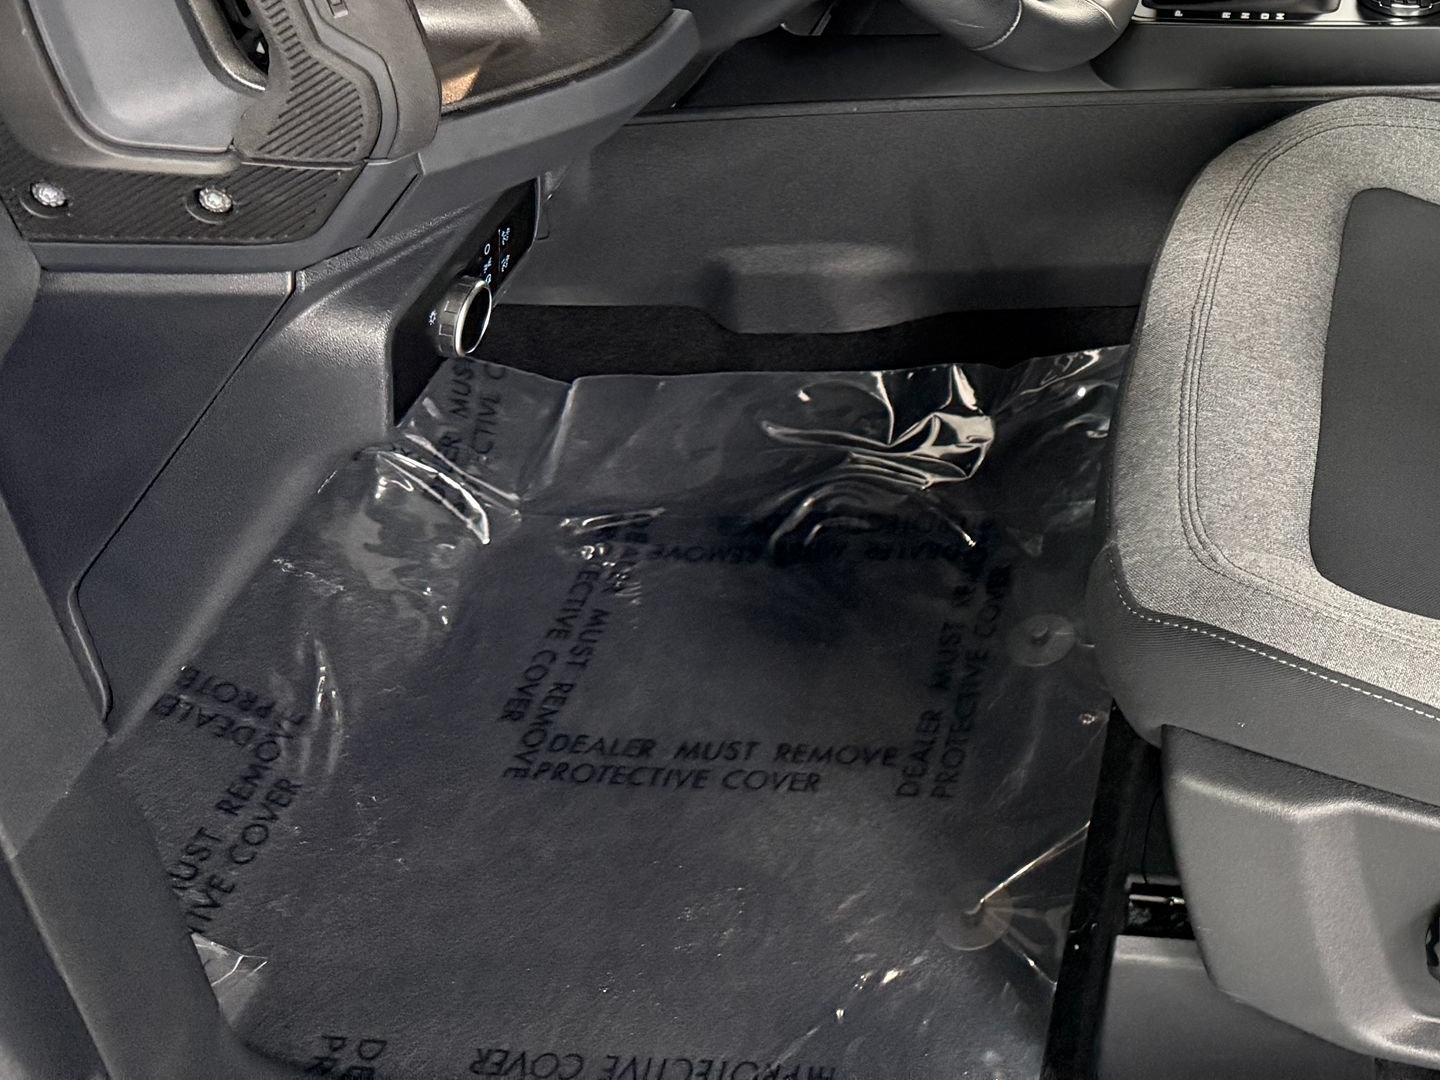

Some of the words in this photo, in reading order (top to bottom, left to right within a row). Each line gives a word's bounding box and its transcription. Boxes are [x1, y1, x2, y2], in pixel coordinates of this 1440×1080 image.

[565, 608, 612, 670] MUST
[496, 649, 558, 722] COVER
[501, 680, 577, 781] REMOVE
[547, 733, 656, 758] DEALER
[673, 740, 761, 761] MUST
[773, 742, 901, 768] REMOVE
[532, 761, 712, 790] PROTECTIVE
[721, 768, 822, 794] COVER
[227, 777, 303, 865] COVER
[469, 1047, 585, 1079] COVER
